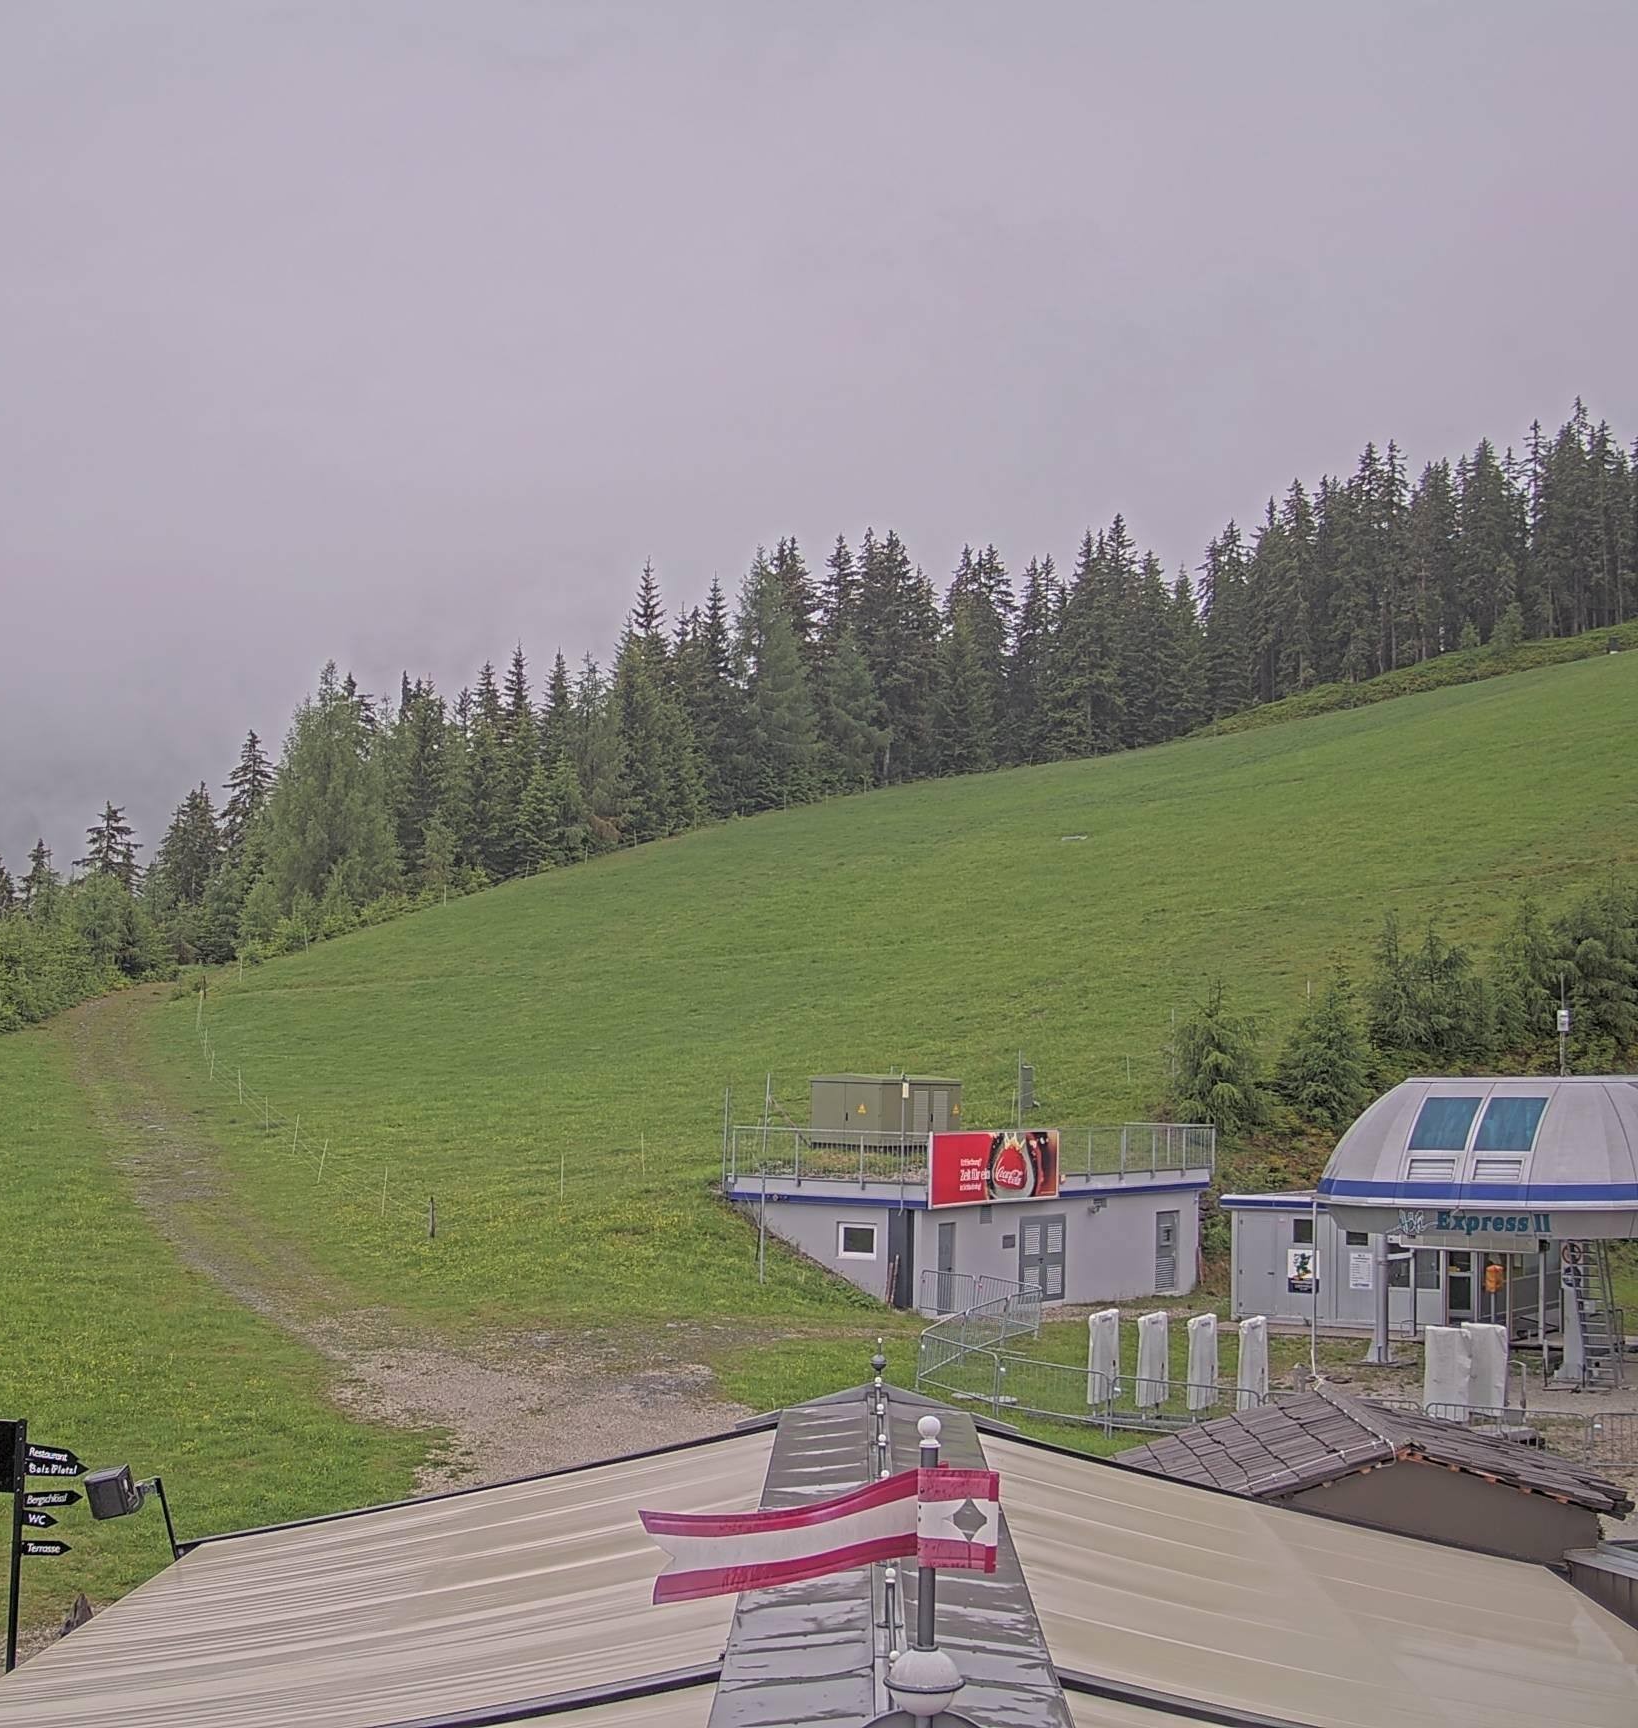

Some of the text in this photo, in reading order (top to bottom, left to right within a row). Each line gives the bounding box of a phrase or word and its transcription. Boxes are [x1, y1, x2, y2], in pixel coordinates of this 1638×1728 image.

[1436, 1210, 1529, 1236] Express
[1533, 1213, 1552, 1232] II
[28, 1513, 46, 1525] WC
[27, 1542, 61, 1553] Terrasse
